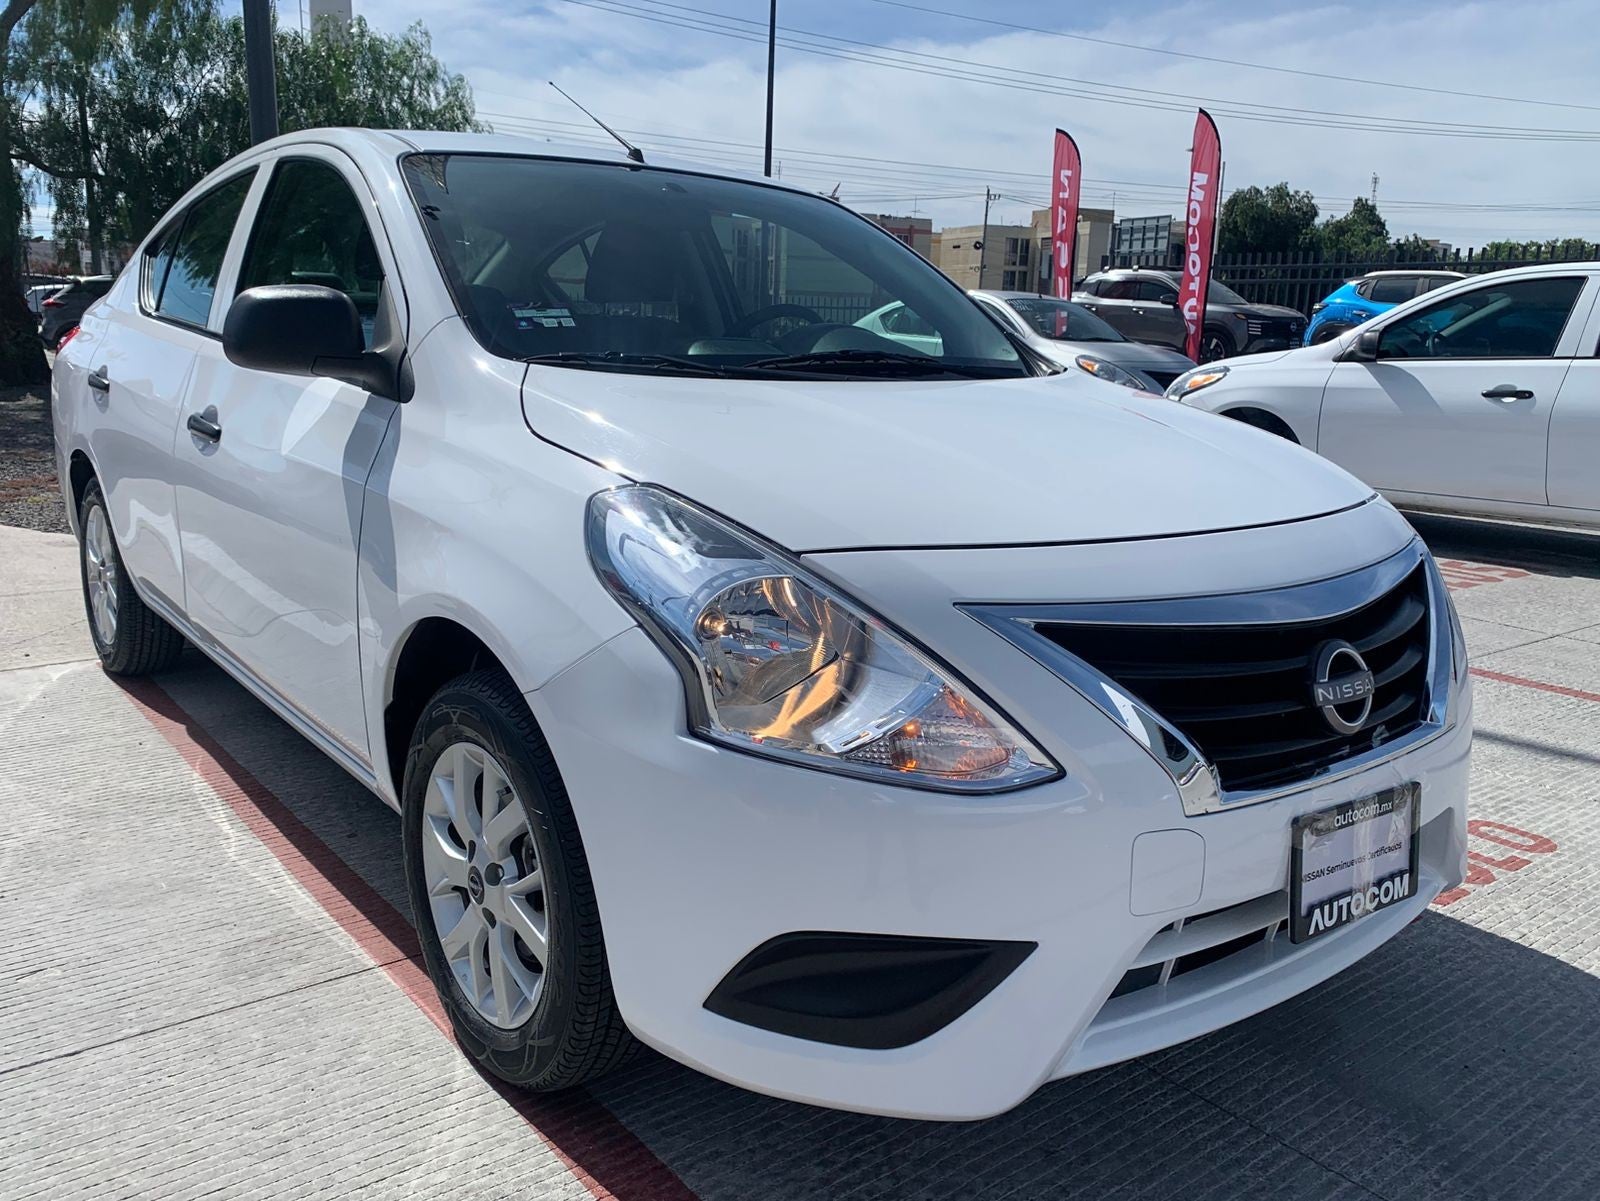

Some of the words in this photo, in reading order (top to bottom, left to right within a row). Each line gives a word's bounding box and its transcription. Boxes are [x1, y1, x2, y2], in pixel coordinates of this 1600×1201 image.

[1317, 679, 1373, 702] NISSA
[1334, 801, 1393, 827] autocom.mx
[1308, 873, 1409, 935] AUTOCOM
